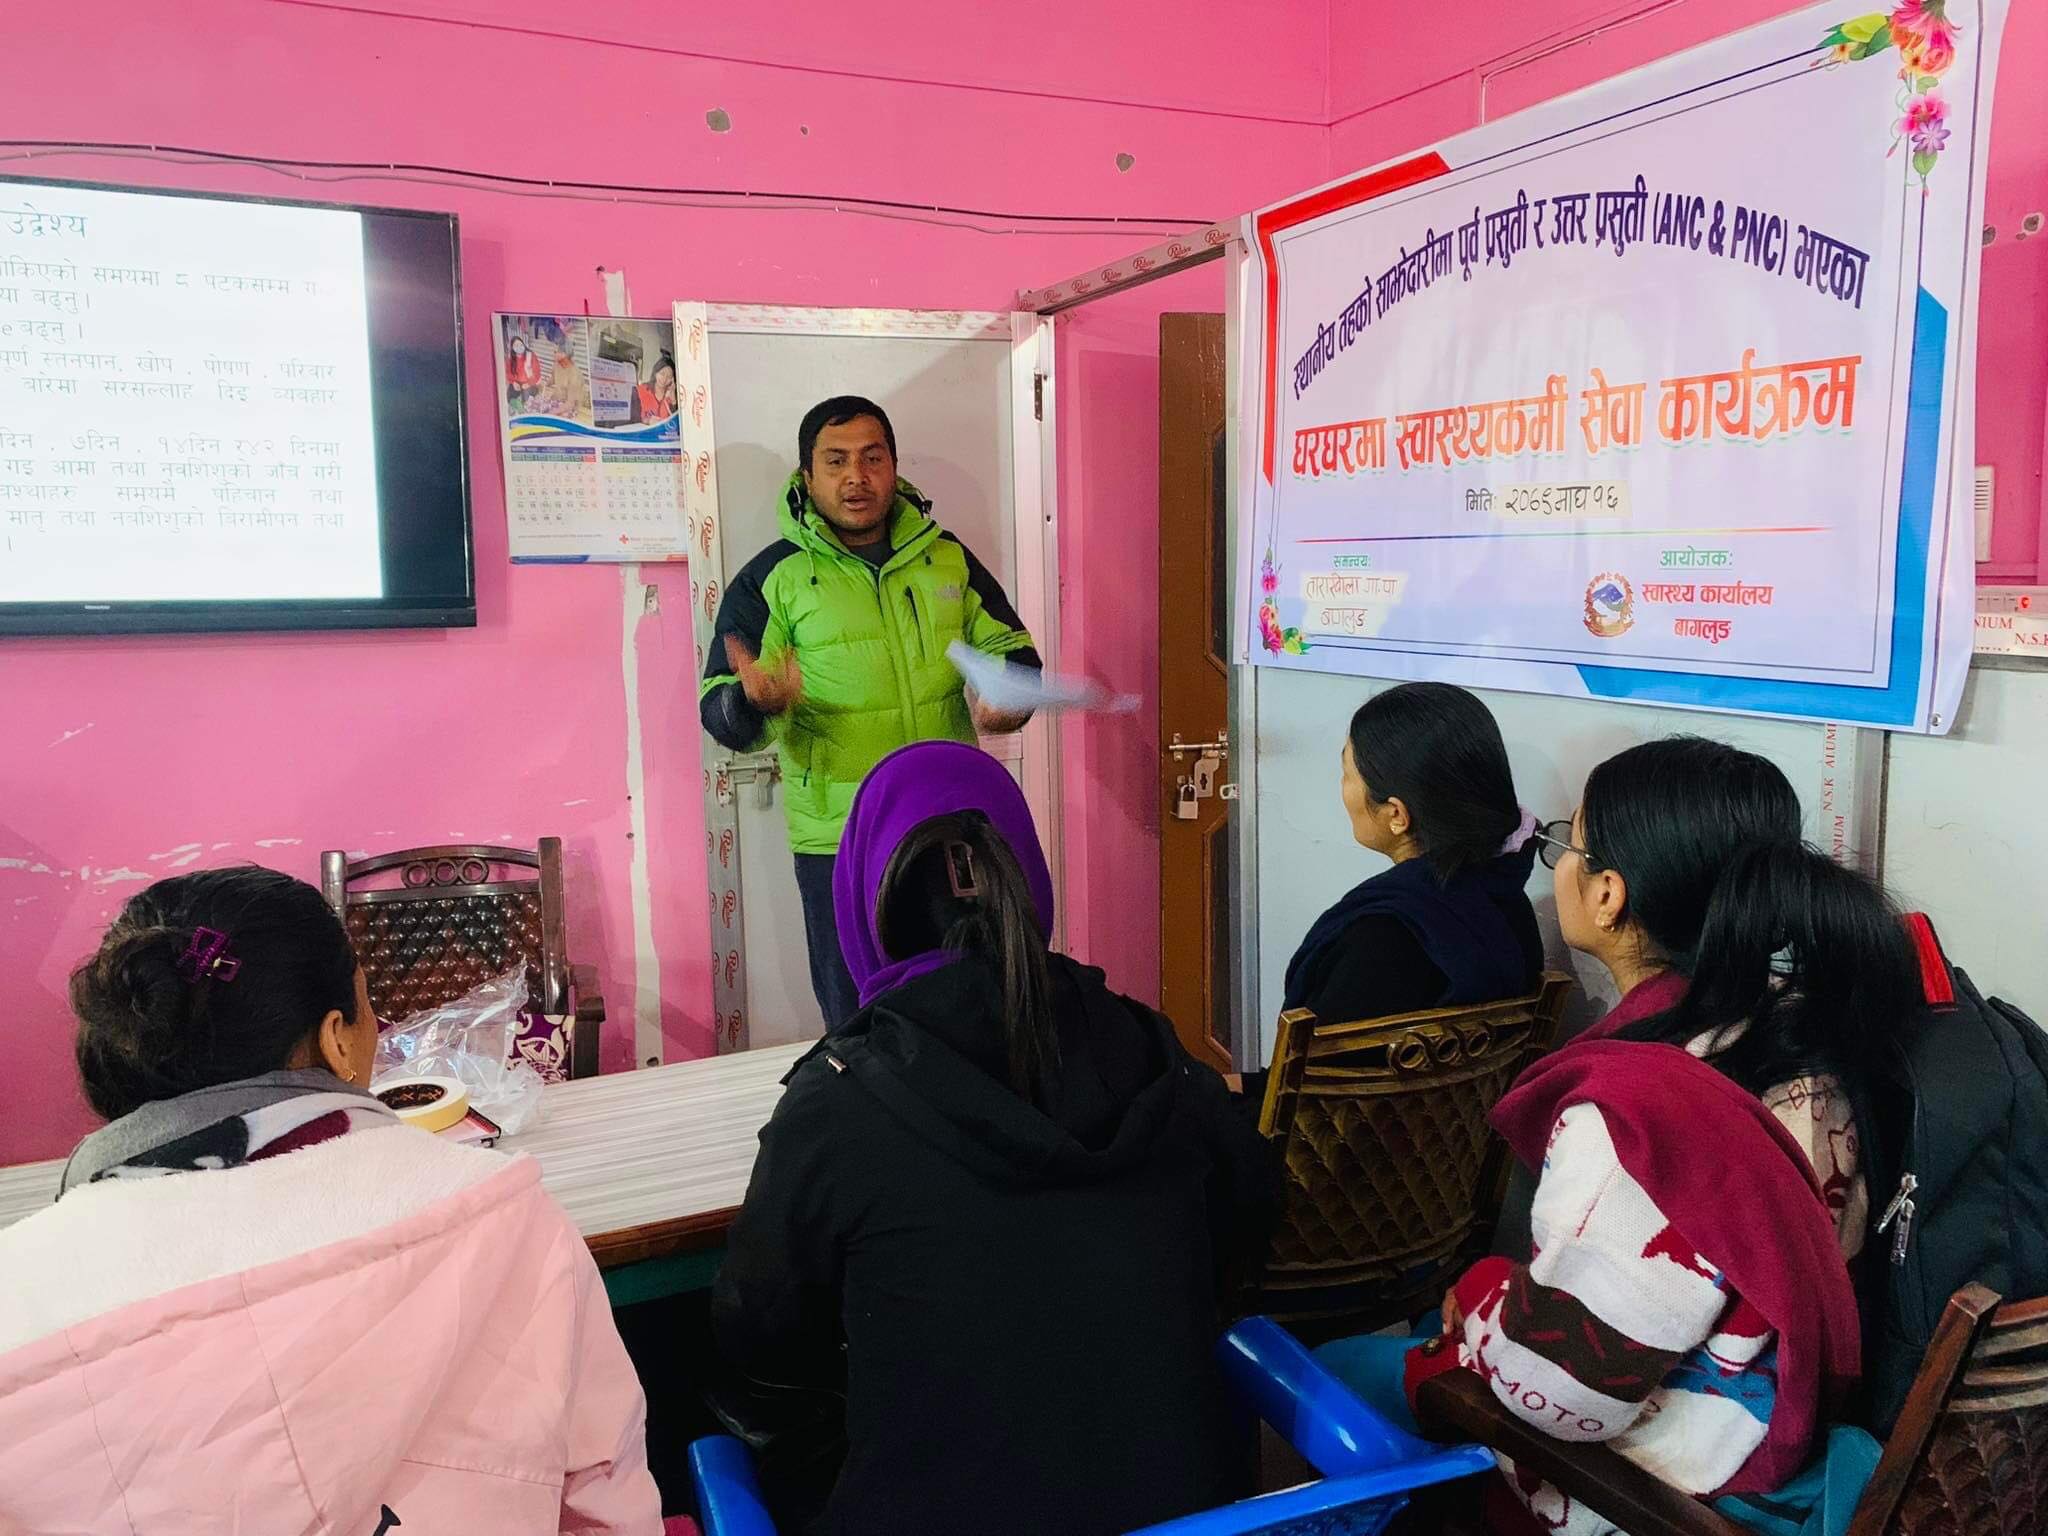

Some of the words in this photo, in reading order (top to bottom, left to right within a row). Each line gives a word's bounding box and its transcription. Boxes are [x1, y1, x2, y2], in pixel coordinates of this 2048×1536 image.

[1294, 323, 1335, 400] स्थानीय
[1339, 276, 1372, 352] तहको
[1458, 206, 1480, 281] पूर्व
[1485, 189, 1528, 268] प्रसुती
[1534, 199, 1547, 249] र
[1551, 193, 1590, 244] उत्तर
[1596, 174, 1648, 257] प्रसुती
[1653, 192, 1705, 250] (ANC
[1708, 200, 1727, 257] &
[1730, 206, 1788, 276] PNC)
[1794, 225, 1870, 309] भएका
[1293, 418, 1387, 478] घरघरमा
[1396, 374, 1568, 472] स्वास्थ्यकर्मी
[1580, 367, 1646, 454] सेवा
[1658, 347, 1861, 442] कार्यक्रम
[1659, 546, 1733, 567] आयोजक:
[1641, 584, 1696, 605] स्वास्थ्य
[1700, 580, 1775, 606] कार्यालय
[1674, 618, 1732, 644] बागलुङ
